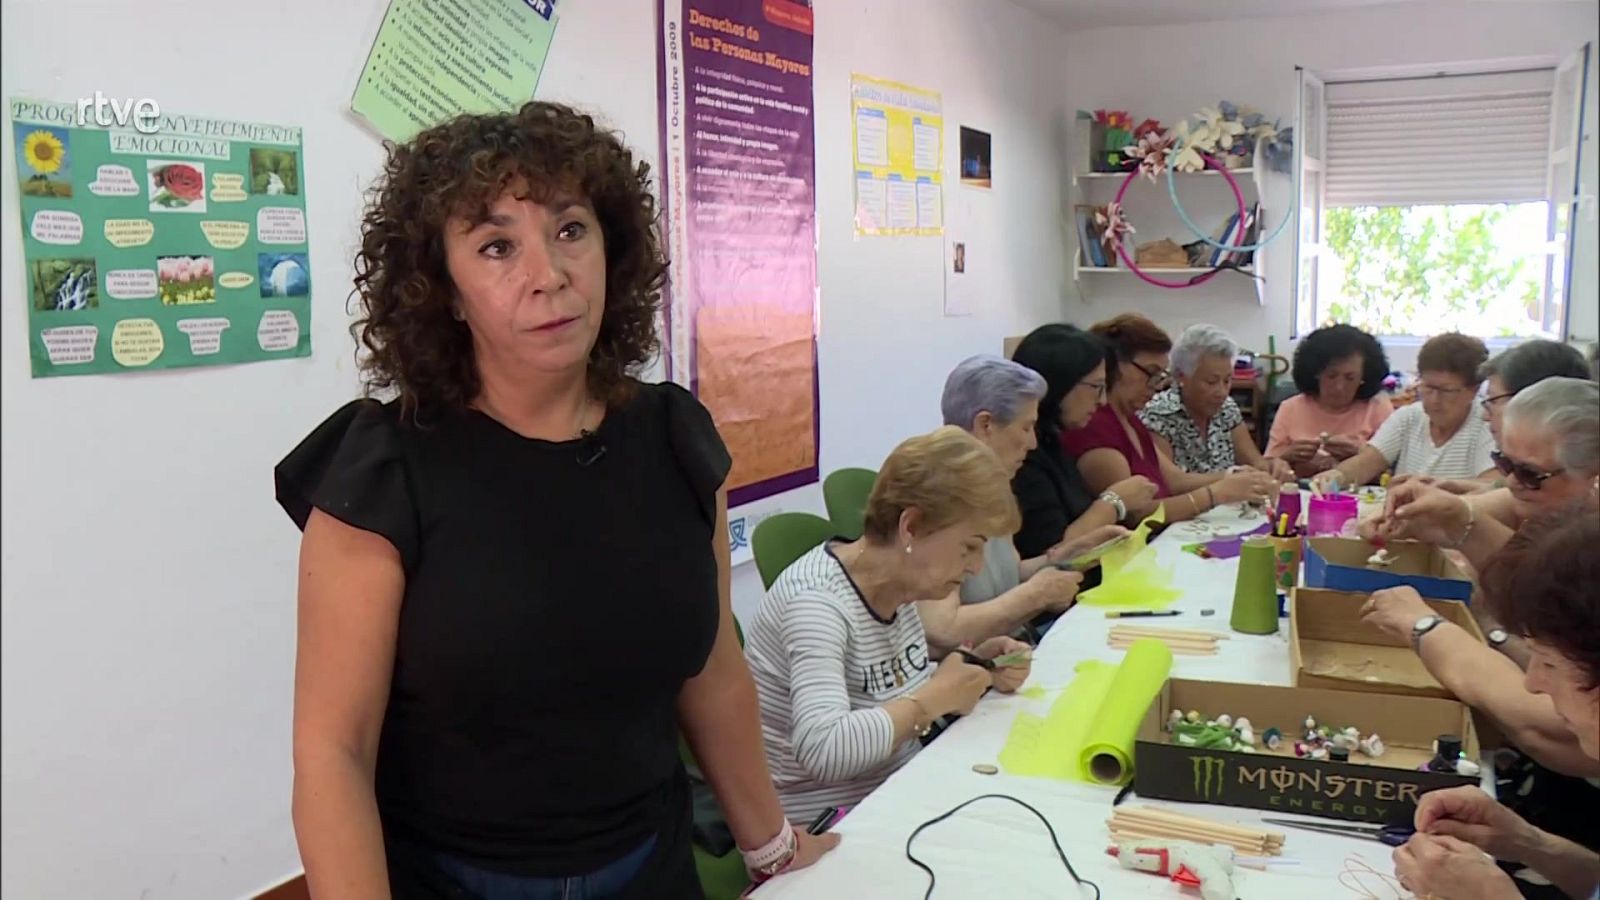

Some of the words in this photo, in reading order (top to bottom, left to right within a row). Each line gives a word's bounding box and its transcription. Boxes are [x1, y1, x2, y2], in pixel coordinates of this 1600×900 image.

[669, 21, 678, 60] 2009
[689, 9, 745, 37] Derechos
[746, 26, 759, 42] de
[689, 31, 710, 50] las
[712, 36, 763, 65] Personas
[765, 52, 810, 76] Mayores
[671, 66, 679, 127] Octubre
[114, 134, 227, 157] EMOCIONAL
[674, 156, 683, 219] Mayores
[1238, 765, 1419, 805] MONSTER
[1269, 796, 1387, 817] ENERGY
